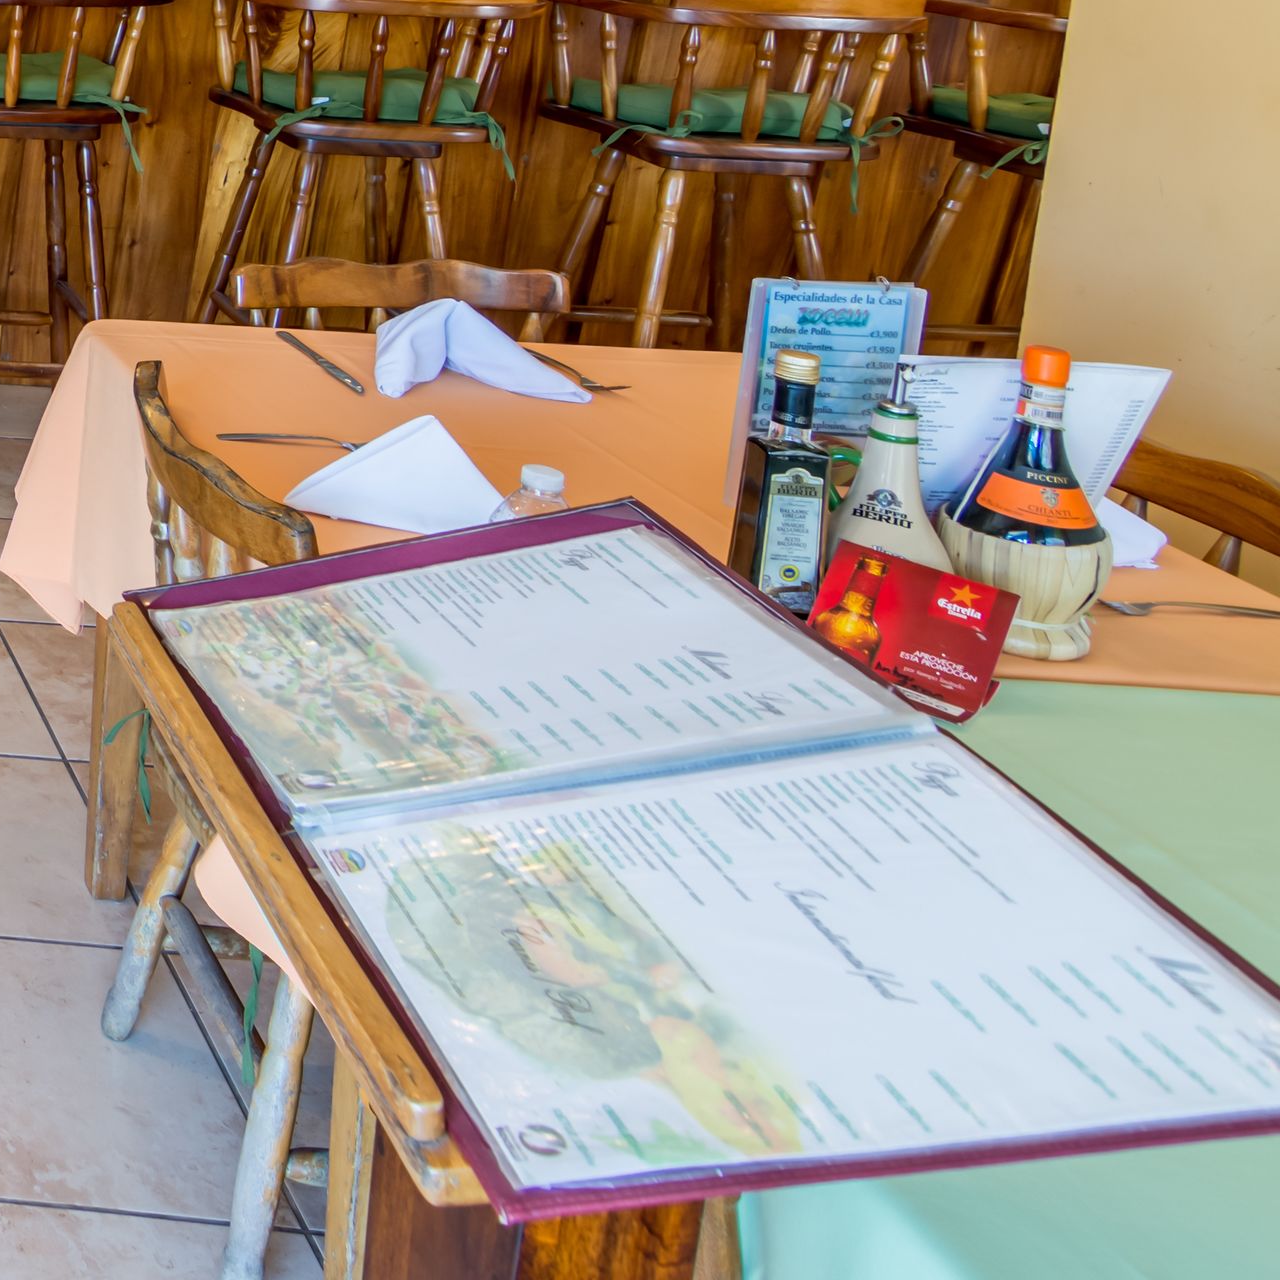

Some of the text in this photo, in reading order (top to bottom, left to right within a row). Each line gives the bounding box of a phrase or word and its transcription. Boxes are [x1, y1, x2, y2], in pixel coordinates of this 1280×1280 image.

[774, 291, 903, 305] Especialidades de la Casa
[770, 326, 796, 334] Dedos
[798, 326, 808, 335] de
[811, 327, 831, 336] Pollo
[1027, 471, 1069, 484] PICCINI
[777, 488, 818, 496] BERIO
[859, 503, 908, 519] FILIPPO
[1027, 504, 1072, 518] CHIANTI
[852, 508, 913, 529] BERIO
[937, 598, 981, 620] Estrella
[900, 651, 919, 663] ESTA
[914, 650, 965, 670] APROVECHE
